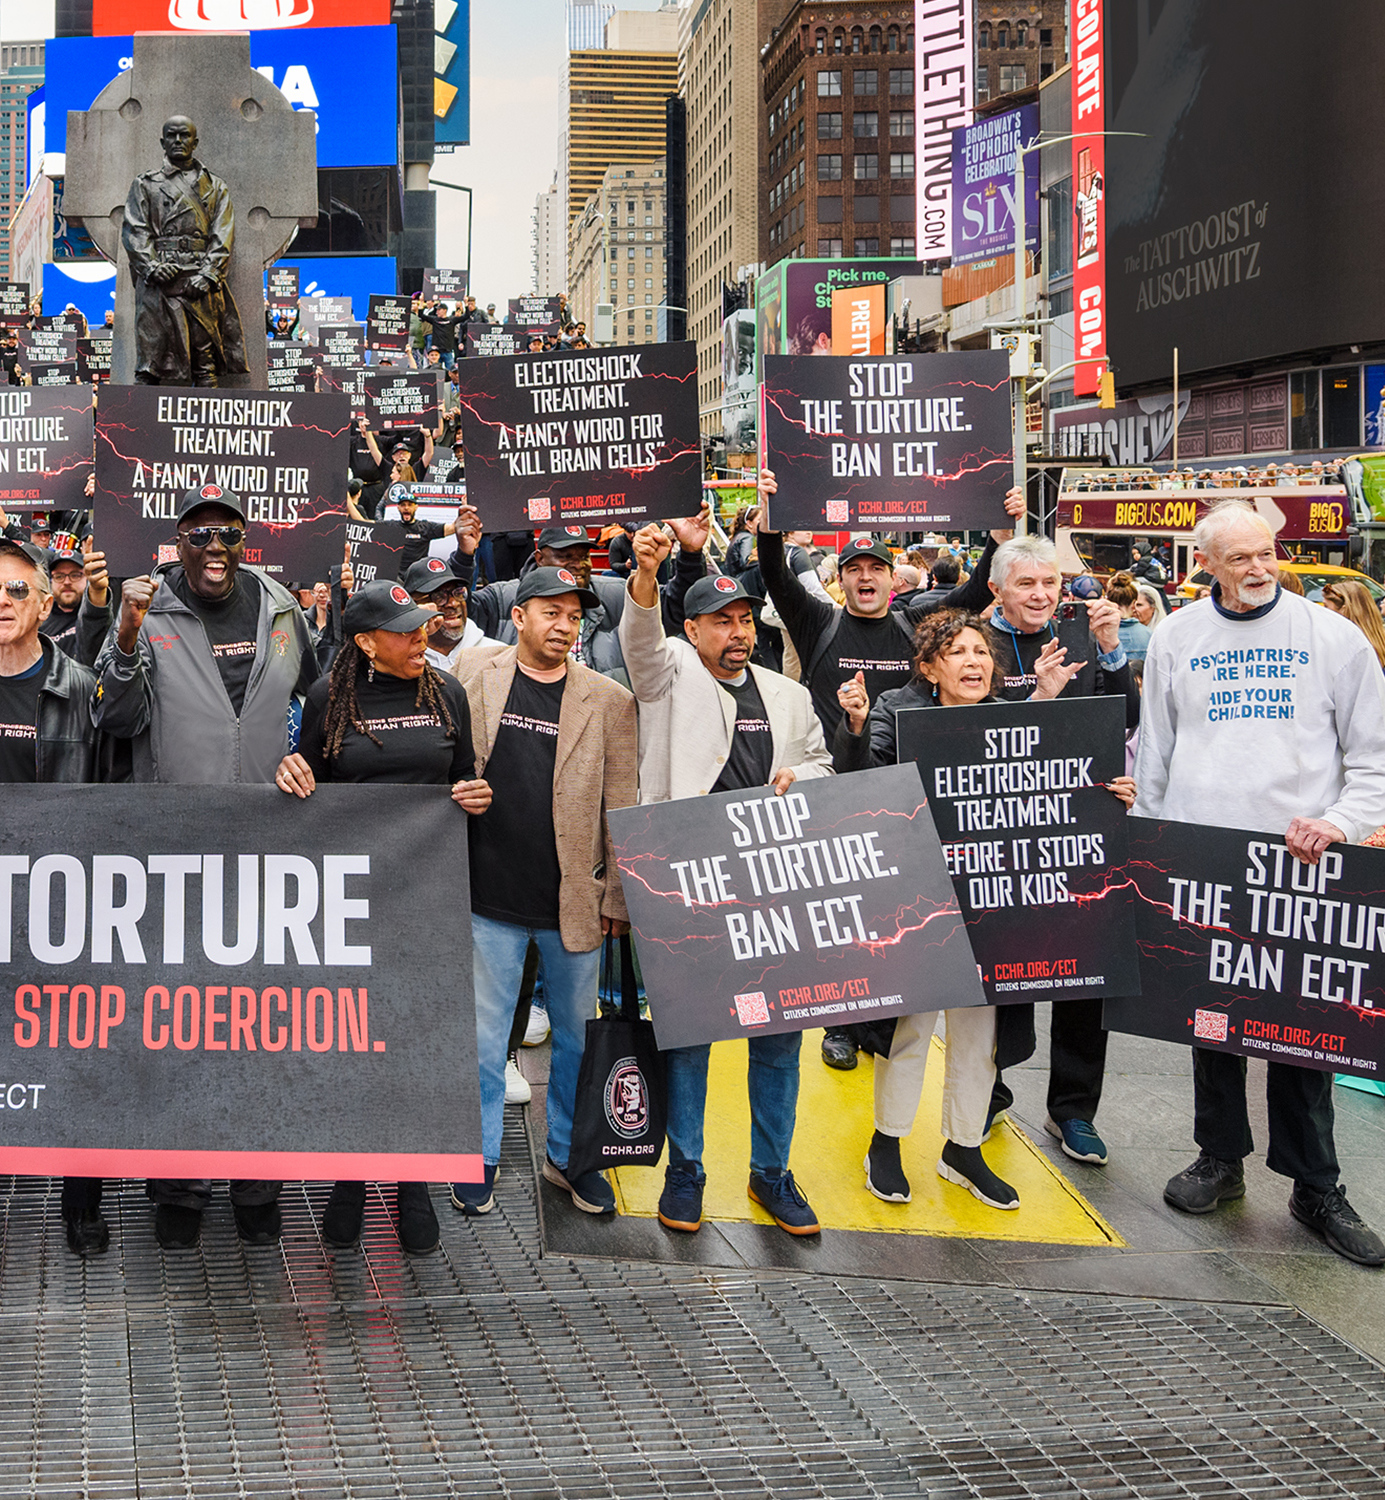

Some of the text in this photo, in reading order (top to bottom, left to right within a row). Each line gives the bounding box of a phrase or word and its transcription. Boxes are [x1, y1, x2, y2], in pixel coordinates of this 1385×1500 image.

[1076, 0, 1102, 121] COLATE
[923, 0, 966, 250] TTLETHING.COM
[966, 111, 1021, 144] BROADWAY'S
[1139, 199, 1256, 274] TATTOOIST
[1255, 202, 1269, 229] of
[827, 268, 890, 282] Pick me.
[1136, 242, 1261, 313] AUSCHWITZ
[285, 349, 302, 358] STOP
[393, 379, 407, 388] STOP
[514, 354, 643, 388] ELECTROSHOCK
[848, 362, 913, 398] STOP
[381, 387, 420, 397] ELECTROSHOCK
[403, 396, 423, 404] BEFORE
[530, 383, 629, 414] TREATMENT.
[157, 396, 293, 428] ELECTROSHOCK
[379, 406, 397, 415] STOPS
[800, 397, 972, 434] THE TORTURE.
[172, 427, 276, 457] TREATMENT.
[497, 414, 664, 450] A FANCY WORD FOR
[17, 448, 51, 472] ECT.
[500, 451, 545, 477] "KILL
[550, 447, 602, 473] BRAIN
[831, 441, 943, 477] BAN ECT.
[132, 462, 309, 494] A FANCY WORD FOR
[410, 485, 453, 494] PETITION TO
[133, 492, 179, 519] "KILL
[560, 493, 626, 510] CCHR.ORG/ECT
[858, 500, 928, 514] CCHR.ORG/ECT
[1115, 501, 1197, 528] BIGBUS.COM
[1309, 503, 1328, 519] BIG
[1308, 518, 1328, 534] BUS
[355, 564, 377, 580] FOR
[839, 662, 910, 671] HUMAN RIGHTS
[1245, 664, 1296, 679] HERE.
[1244, 688, 1292, 703] YOUR
[1208, 703, 1295, 722] CHILDREN!
[984, 725, 1041, 759] STOP
[934, 757, 1094, 798] ELECTROSHOCK
[726, 792, 811, 848] STOP
[953, 793, 1077, 832] TREATMENT.
[670, 831, 900, 907] THE TORTURE.
[942, 833, 1105, 875] EFORE IT STOPS
[1245, 841, 1343, 895] STOP
[969, 872, 1076, 909] OUR KIDS.
[726, 894, 879, 960] BAN ECT.
[1168, 877, 1385, 954] THE TORTUR
[994, 959, 1078, 980] CCHR.ORG/ECT
[995, 976, 1105, 992] CITIZENS COMMISSION ON HUMAN RIGHTS
[1209, 938, 1373, 1009] BAN ECT.
[778, 977, 870, 1008] CCHR.ORG/ECT
[783, 994, 903, 1020] CITIZENS COMMISSION ON HUMAN RIGHTS
[14, 983, 127, 1049] STOP
[142, 985, 386, 1053] COERCION.
[1243, 1018, 1346, 1053] CCHR.ORG/ECT
[1242, 1037, 1377, 1071] CITIZENS COMMISSION HUMAN RIGHTS
[602, 1145, 655, 1155] CCHR.ORG
